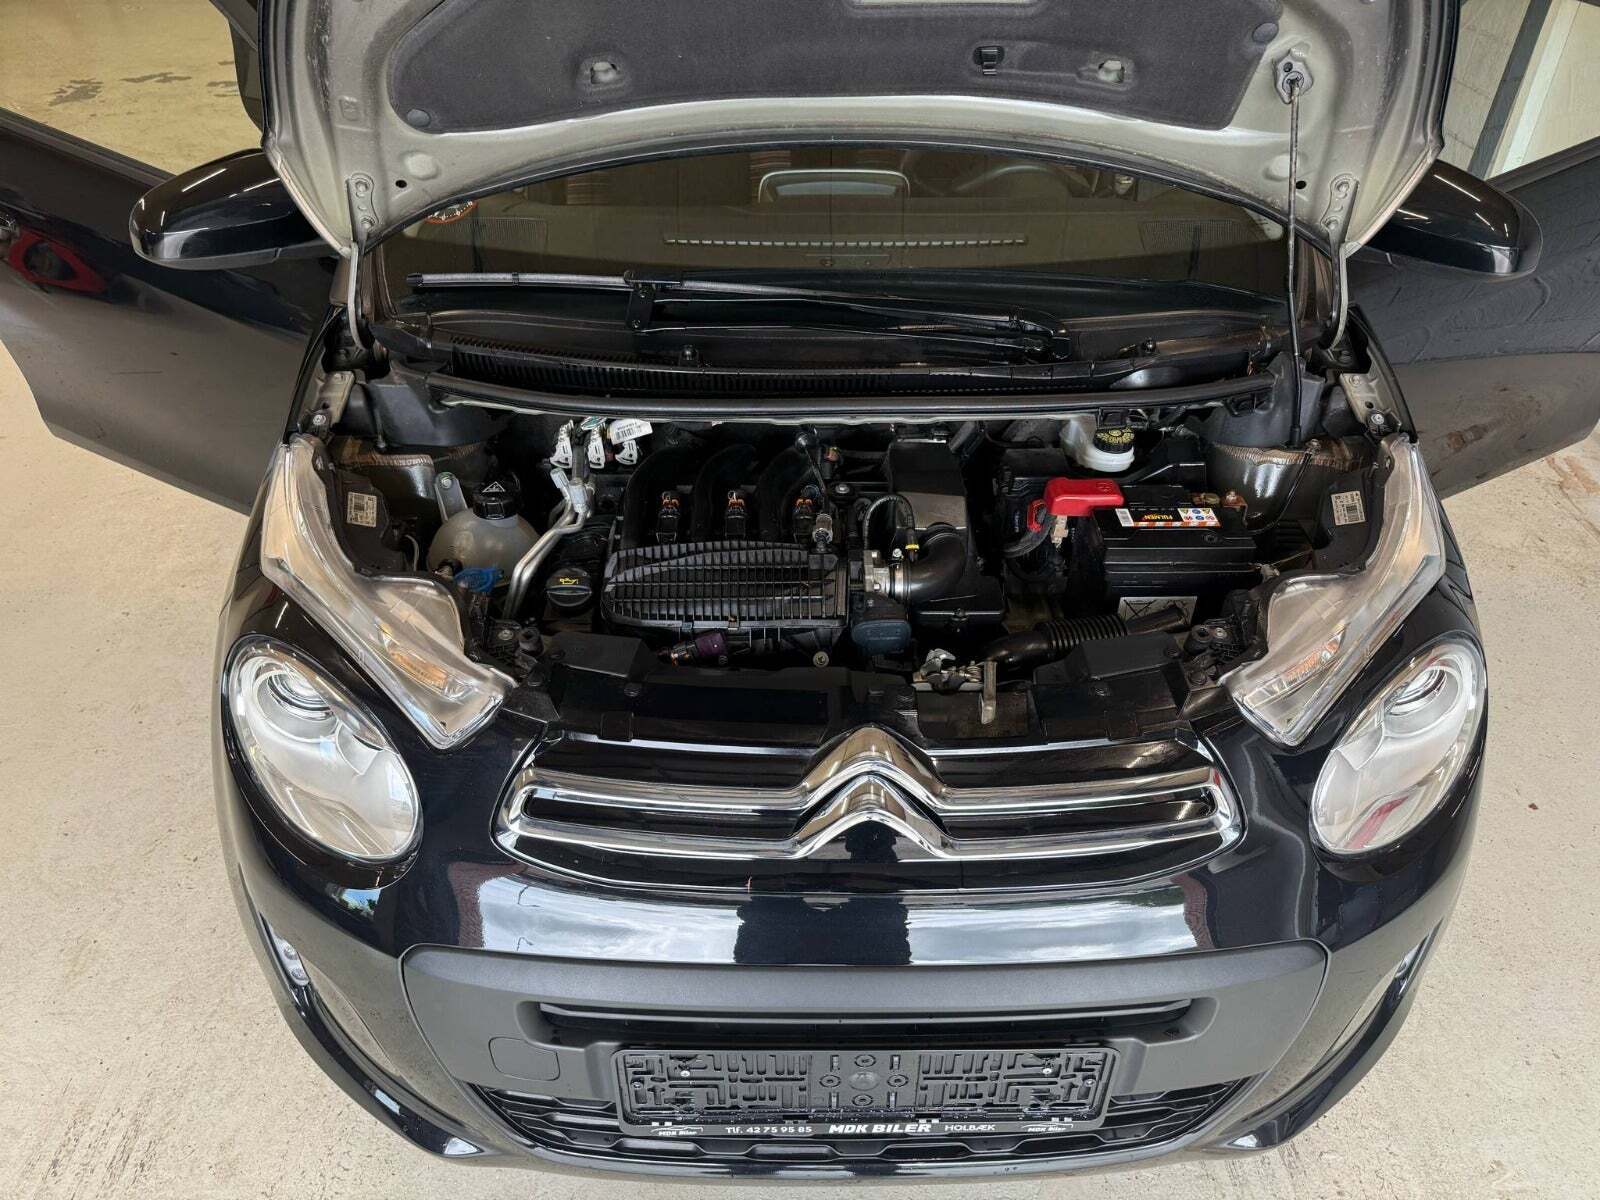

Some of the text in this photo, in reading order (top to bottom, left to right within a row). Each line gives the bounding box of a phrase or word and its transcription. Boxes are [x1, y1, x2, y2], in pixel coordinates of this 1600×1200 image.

[725, 1126, 743, 1134] Tlf.
[746, 1126, 761, 1134] 42
[828, 1123, 932, 1134] MDK BILER
[944, 1124, 996, 1132] HOLBÆK
